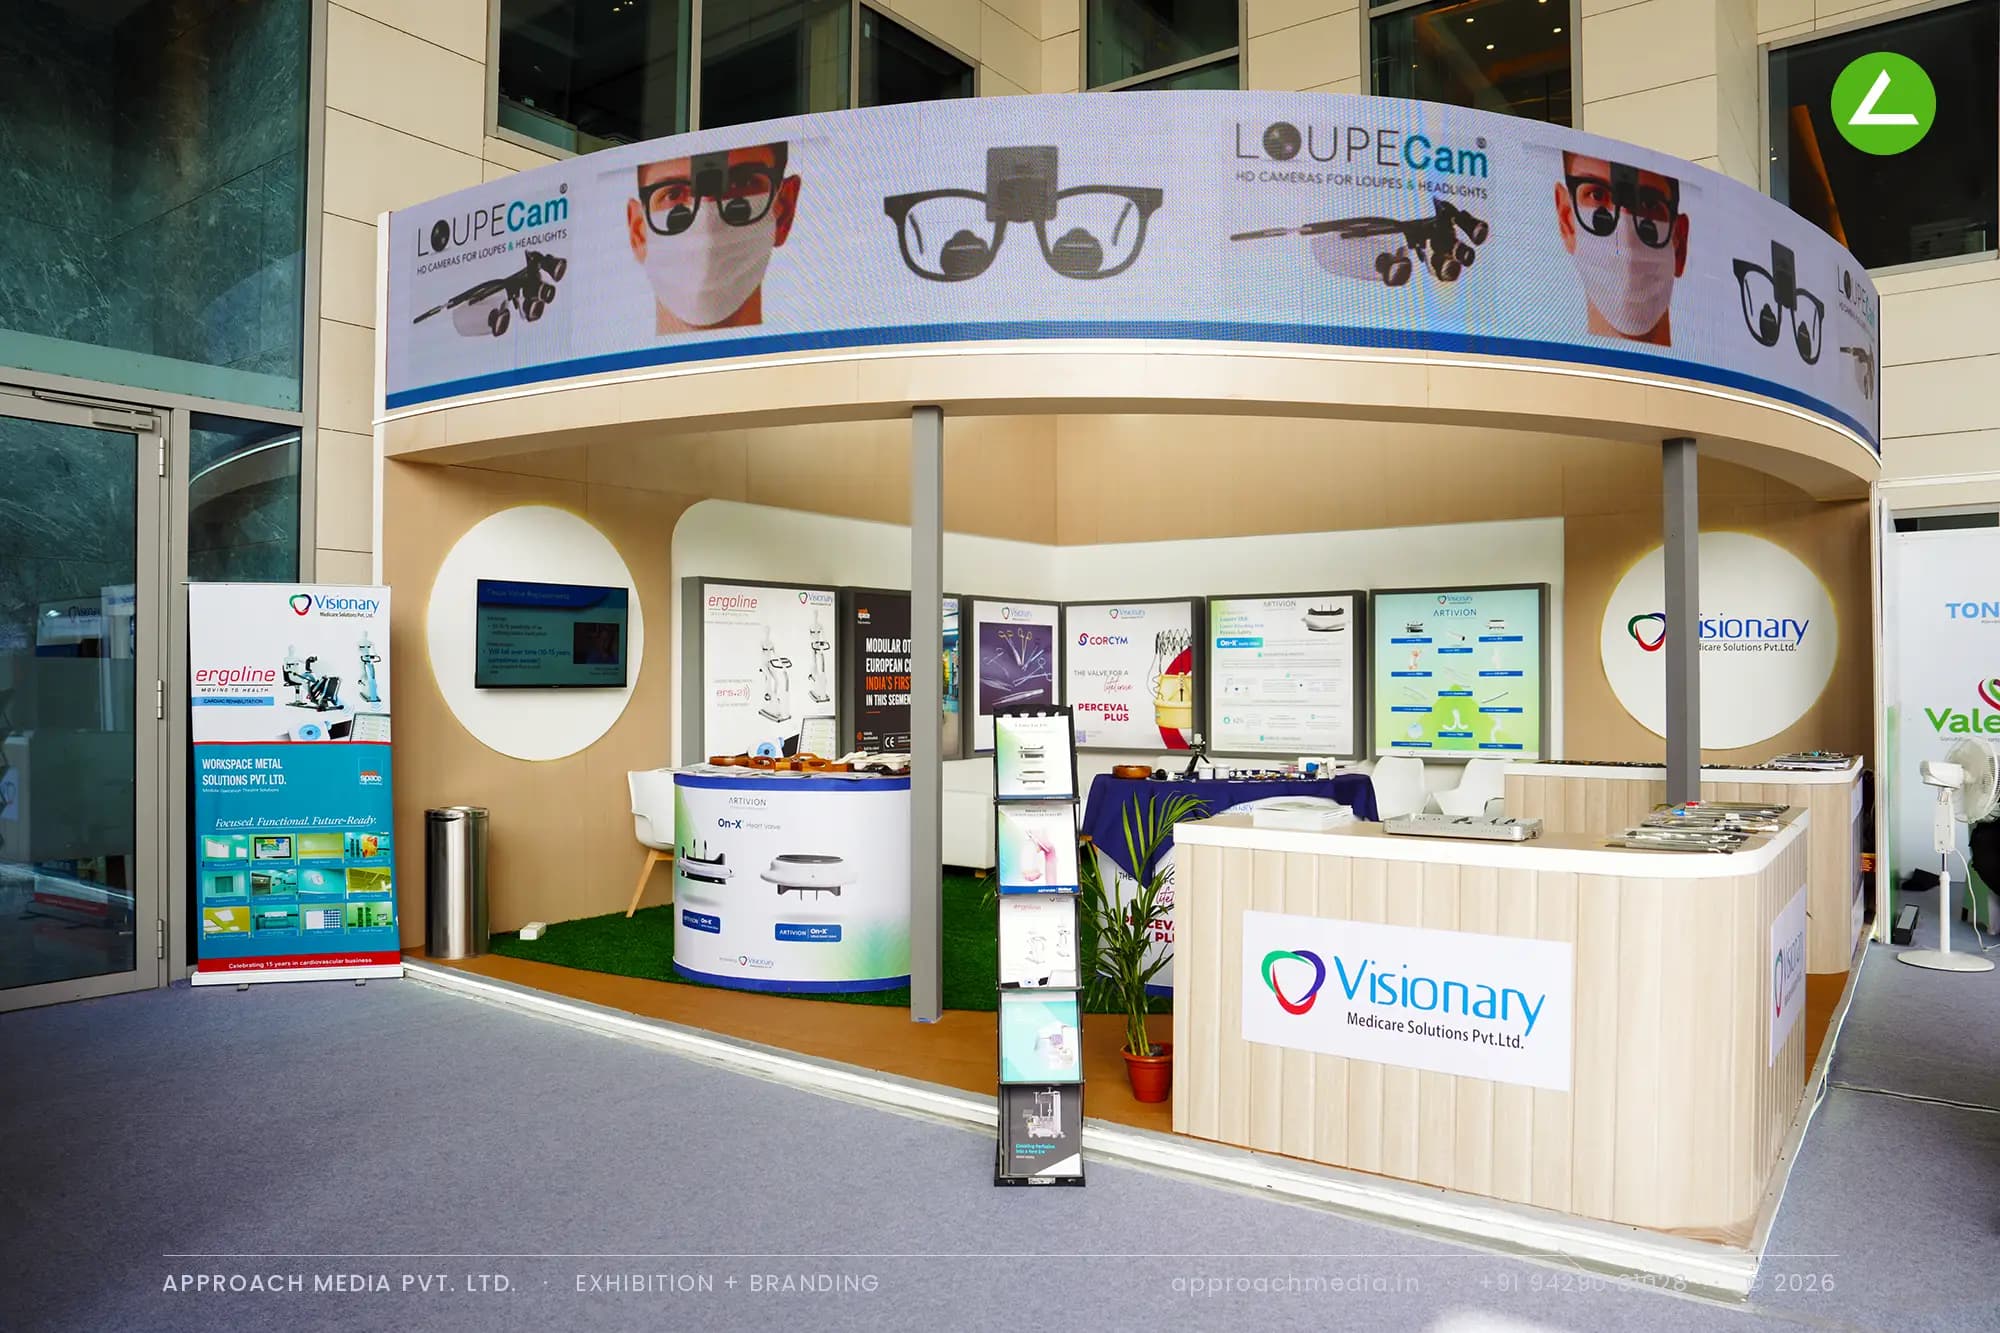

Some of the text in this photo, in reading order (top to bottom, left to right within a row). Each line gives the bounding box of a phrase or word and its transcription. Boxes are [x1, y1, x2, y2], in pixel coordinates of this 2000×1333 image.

[1236, 171, 1256, 182] HD
[1258, 171, 1322, 184] CAMERAS
[1326, 173, 1351, 186] FOR
[1355, 175, 1403, 190] LOUPES
[1418, 181, 1488, 200] HEADLIGHTS
[417, 228, 568, 276] HD CAMERAS FOR LOUPES & HEADLIGHTS
[314, 594, 379, 614] Visionary
[708, 595, 758, 611] ergoline
[1433, 609, 1477, 617] ARTIVION
[1698, 613, 1809, 646] isionary
[866, 637, 912, 653] MODULAR OT
[1089, 636, 1128, 646] CORCYM
[1723, 643, 1762, 652] Solutions
[866, 658, 903, 673] EUROPEAN
[196, 666, 276, 686] ergoline
[866, 675, 892, 691] INDIA'S
[866, 694, 873, 706] IN
[874, 694, 887, 706] THIS
[1078, 703, 1129, 712] PERCEVAL
[1104, 713, 1129, 722] PLUS
[1924, 708, 2000, 734] Vale
[202, 758, 283, 770] WORKSPACE METAL
[202, 774, 287, 786] SOLUTIONS PVT. LTD.
[729, 797, 767, 806] ARTIVION
[215, 815, 378, 828] Focused. Functional. Future-Ready.
[717, 818, 742, 829] On-X
[1119, 872, 1133, 880] THE
[1333, 955, 1545, 1037] Visionary
[1347, 1011, 1404, 1033] Medicare
[1407, 1020, 1469, 1042] Solutions
